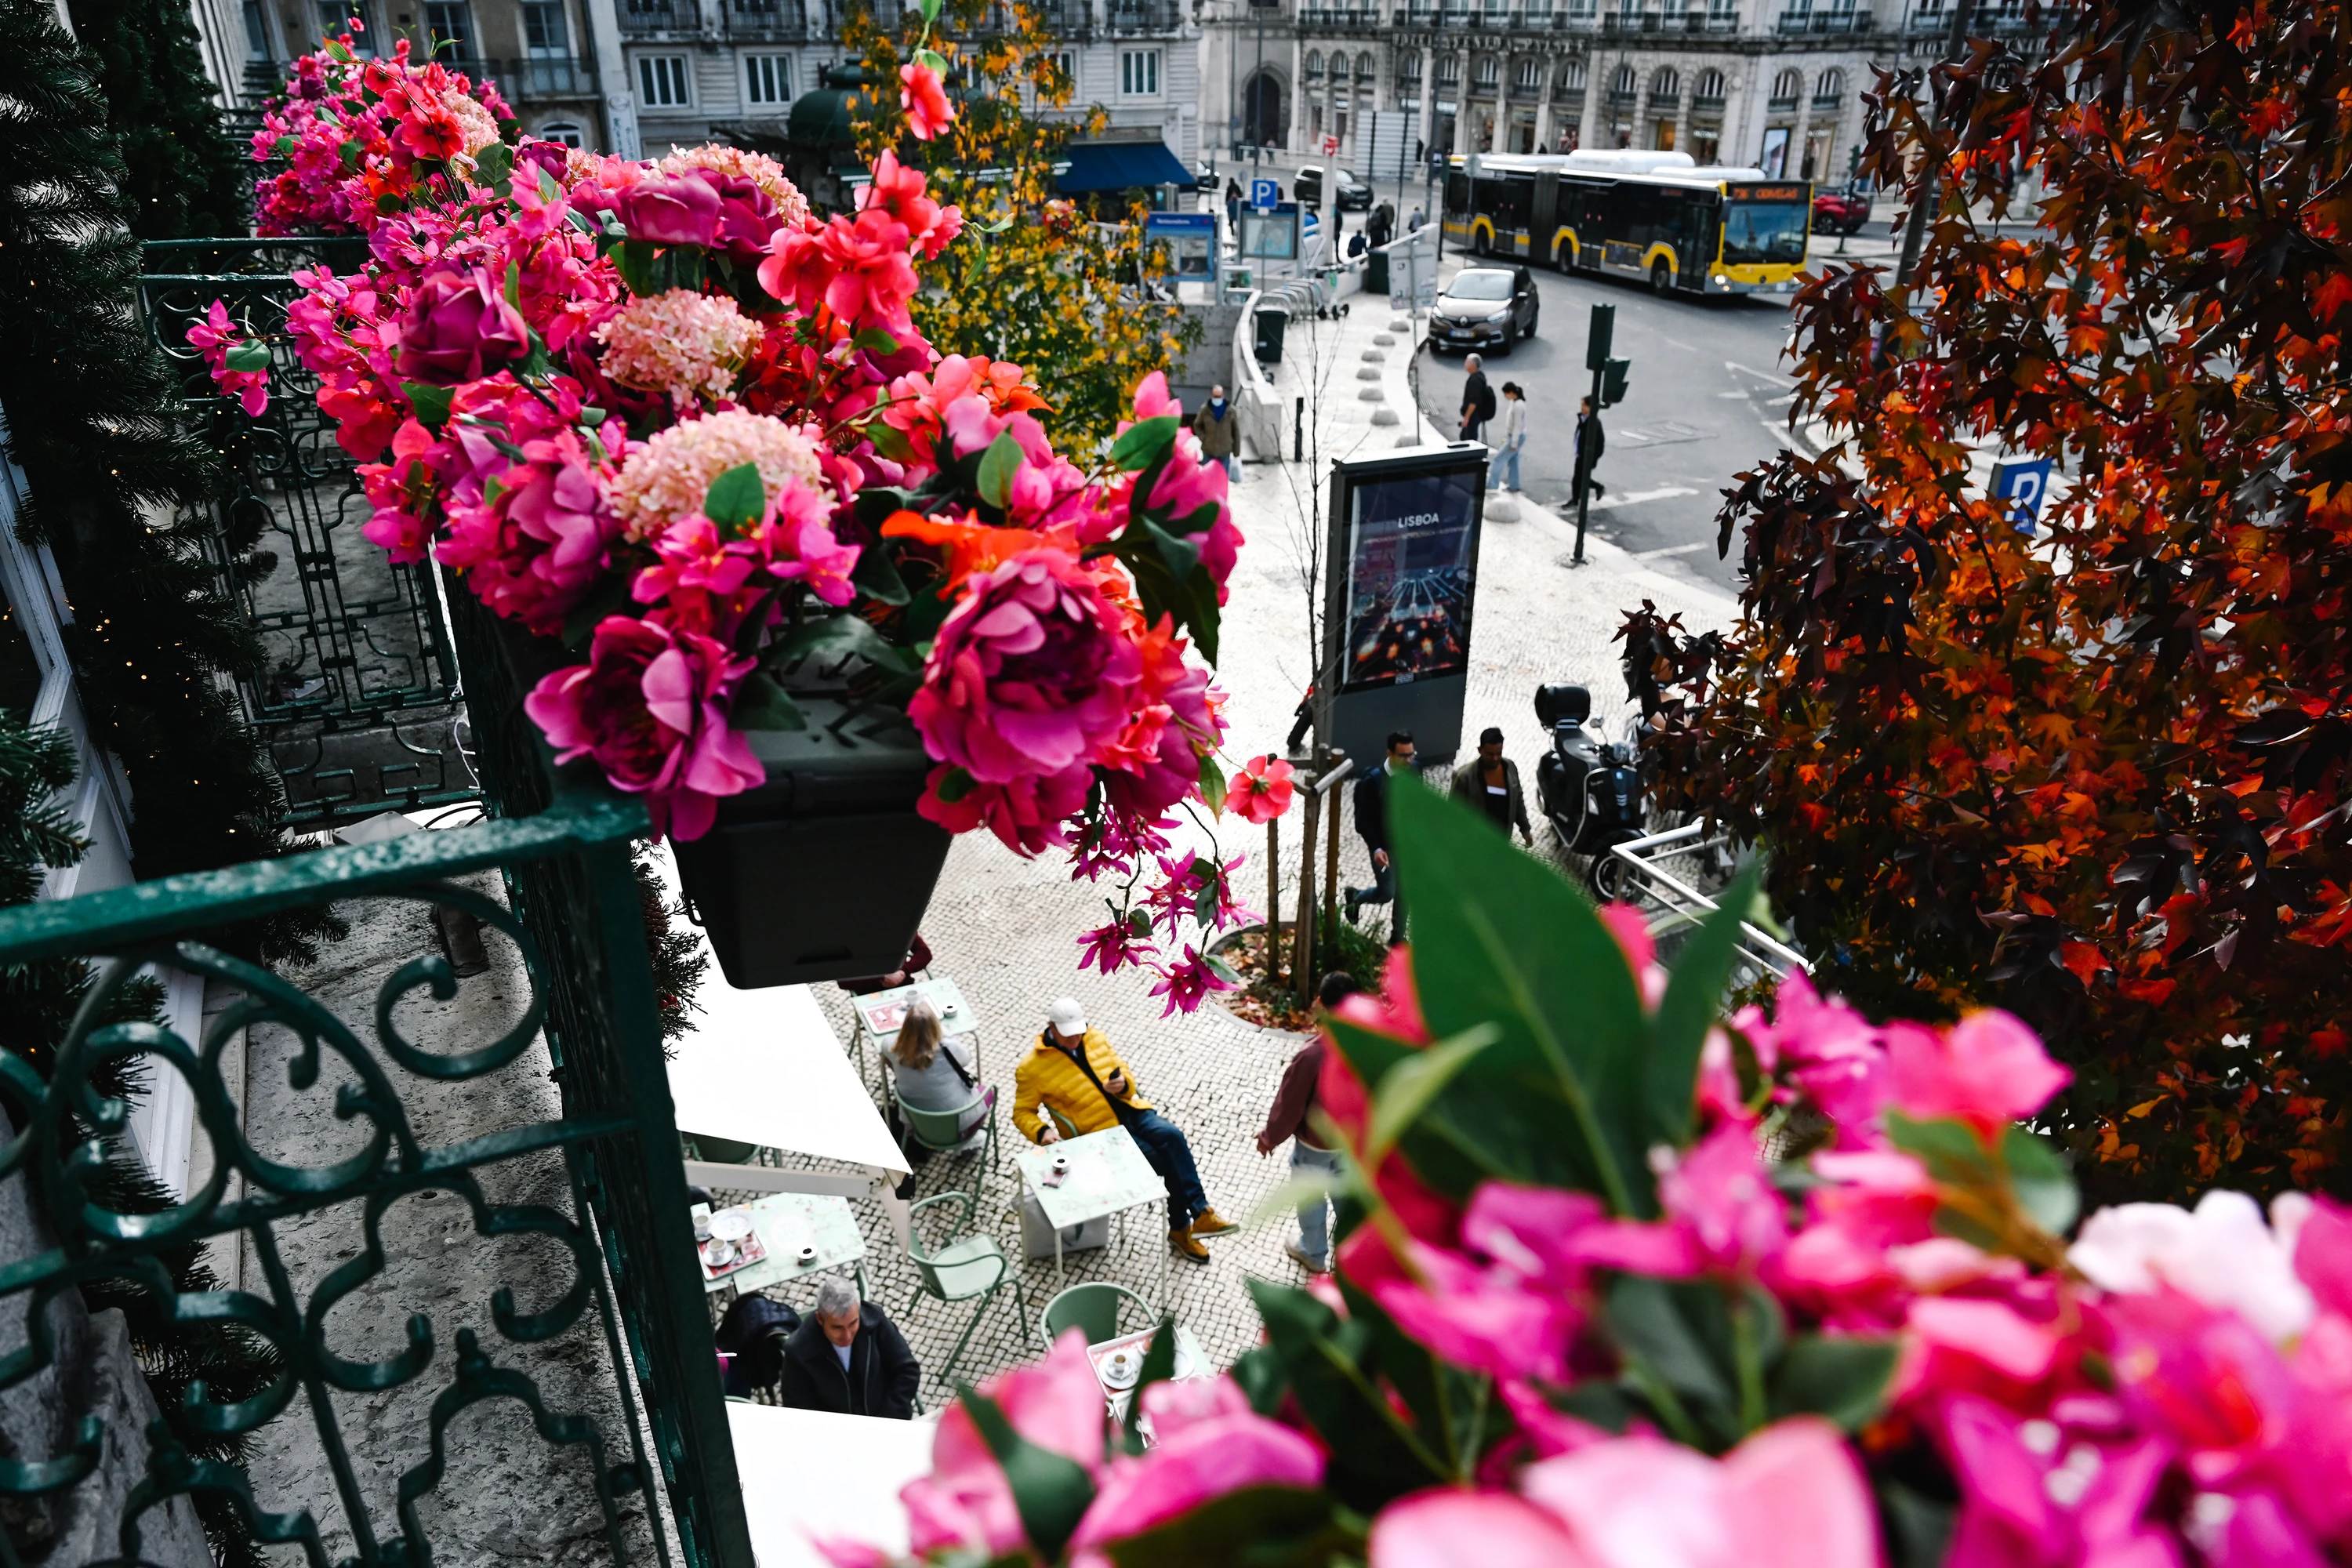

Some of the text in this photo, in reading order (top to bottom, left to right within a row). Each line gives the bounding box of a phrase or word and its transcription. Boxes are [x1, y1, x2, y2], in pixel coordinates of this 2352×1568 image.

[1913, 39, 1975, 56] HOTL
[1257, 182, 1271, 205] P
[2005, 471, 2041, 521] P
[1398, 513, 1439, 528] LISBOA
